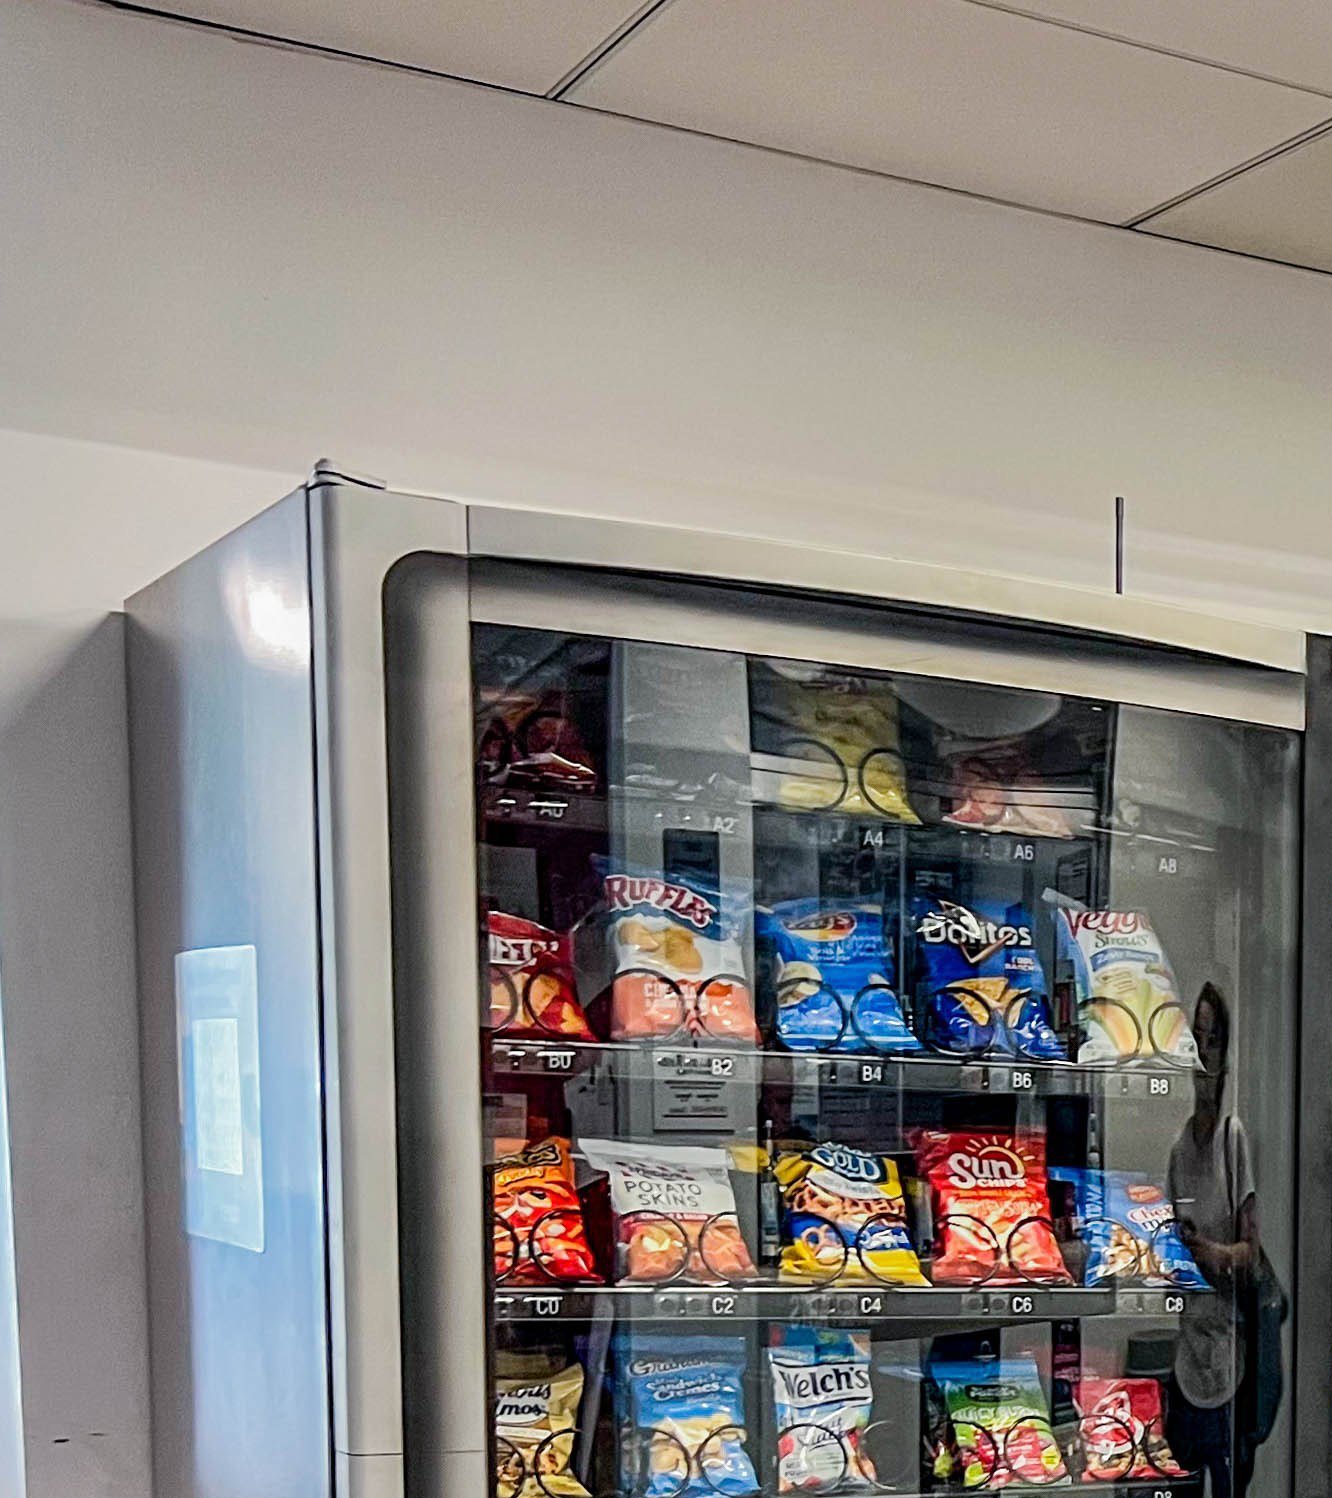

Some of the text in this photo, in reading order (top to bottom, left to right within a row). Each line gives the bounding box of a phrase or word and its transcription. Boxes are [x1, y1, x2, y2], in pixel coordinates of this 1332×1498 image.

[713, 819, 735, 833] A2
[863, 830, 883, 846] A4
[1014, 844, 1033, 860] A6
[1158, 858, 1177, 873] A8
[711, 1059, 733, 1075] B2
[862, 1066, 882, 1082] B4
[1012, 1073, 1032, 1089] B6
[1150, 1079, 1169, 1094] B8
[811, 1147, 880, 1180] GOLD
[624, 1181, 702, 1196] POTATO
[639, 1194, 699, 1208] SKINS
[536, 1299, 560, 1315] C0
[712, 1298, 734, 1314] C2
[861, 1298, 881, 1314] C4
[1012, 1297, 1032, 1313] C6
[1166, 1297, 1184, 1312] C8
[780, 1365, 869, 1399] Welch's
[497, 1401, 546, 1419] mos
